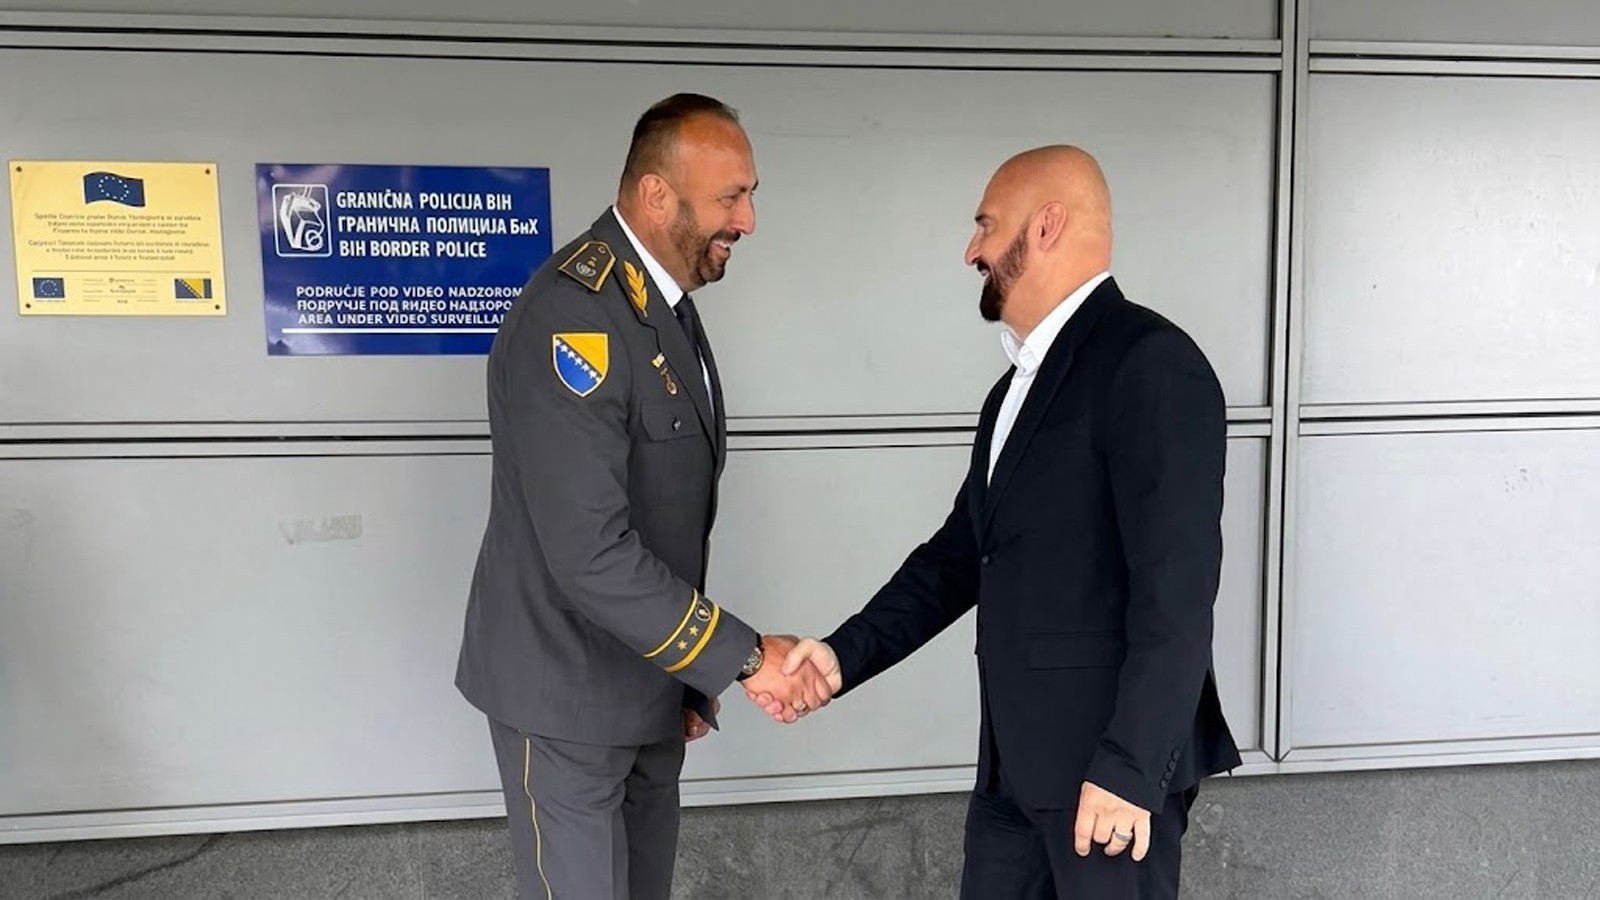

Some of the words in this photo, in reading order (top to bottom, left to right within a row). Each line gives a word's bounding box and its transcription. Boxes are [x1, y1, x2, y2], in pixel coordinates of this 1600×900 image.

[336, 188, 413, 209] GRANIČNA
[420, 193, 483, 210] POLICIJA
[486, 194, 512, 211] BIH
[338, 216, 420, 233] ГРАНИЧНА
[427, 217, 507, 237] ПОЛИЦИЈА
[339, 240, 366, 257] BIH
[370, 240, 430, 257] BORDER
[436, 241, 487, 257] POLICE
[370, 286, 399, 298] POD
[403, 286, 444, 297] VIDEO
[369, 300, 399, 313] ПОД
[298, 313, 333, 325] AREA
[337, 313, 383, 325] UNDER
[386, 313, 427, 325] VIDEO
[431, 313, 504, 325] SURVEILLA
